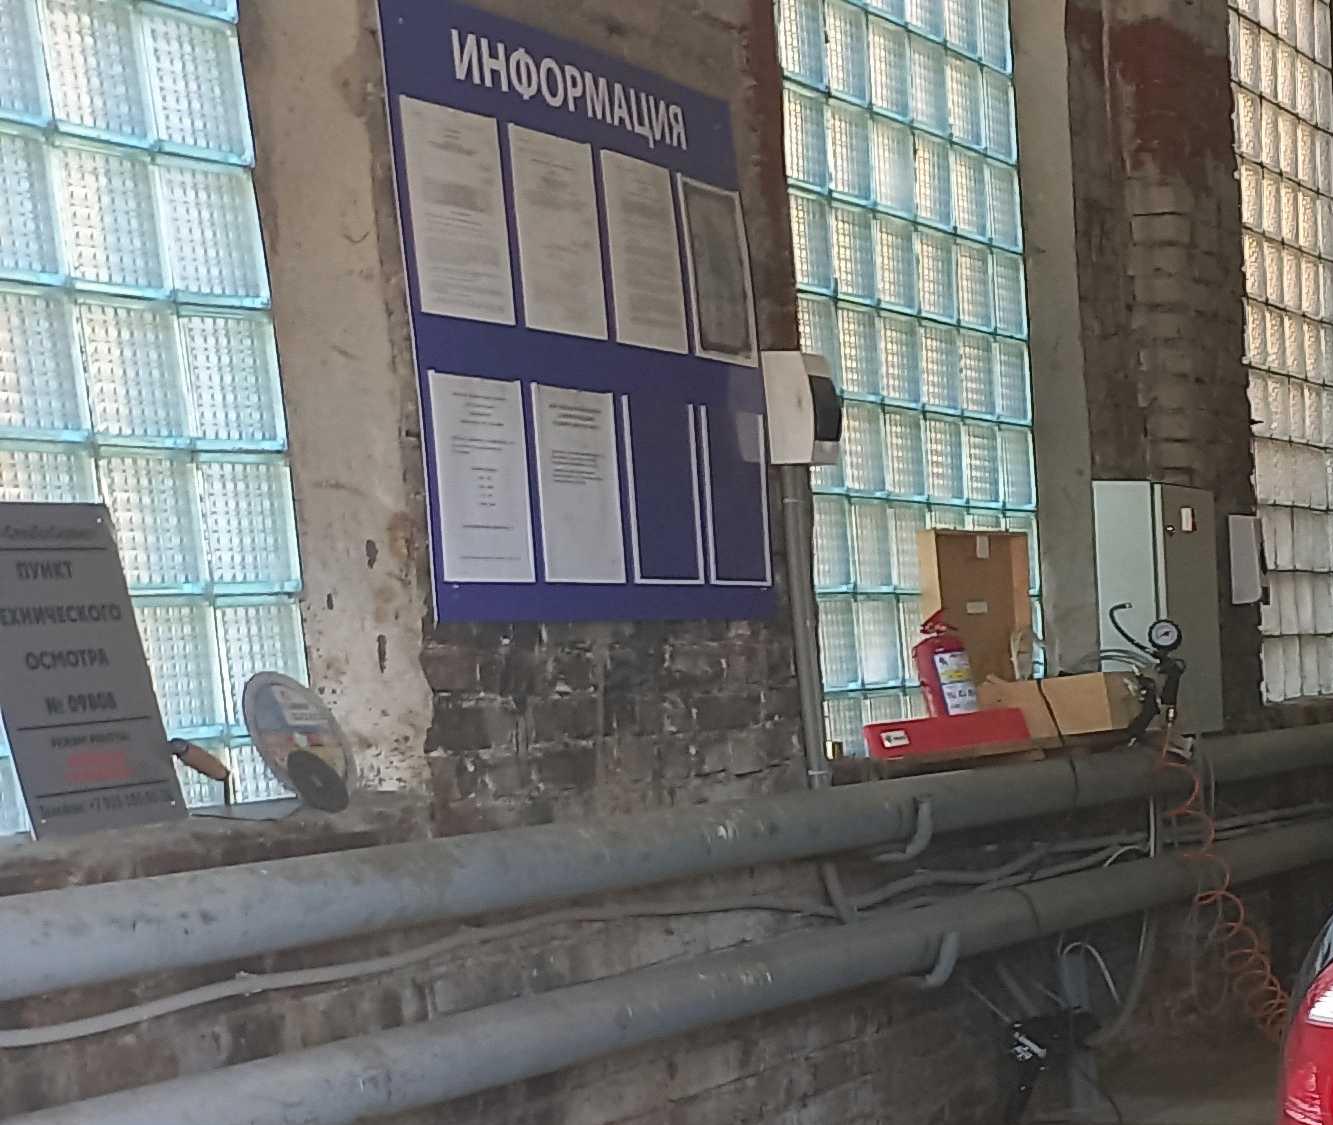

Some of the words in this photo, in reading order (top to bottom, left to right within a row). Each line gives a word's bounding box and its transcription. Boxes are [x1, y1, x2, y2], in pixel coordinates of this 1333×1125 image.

[450, 28, 688, 150] ИНФОРМАЦИЯ
[15, 560, 73, 580] ПУНКТ
[0, 603, 122, 626] ЕХНИЧЕСКОГО
[25, 648, 110, 670] ОСМОТРА
